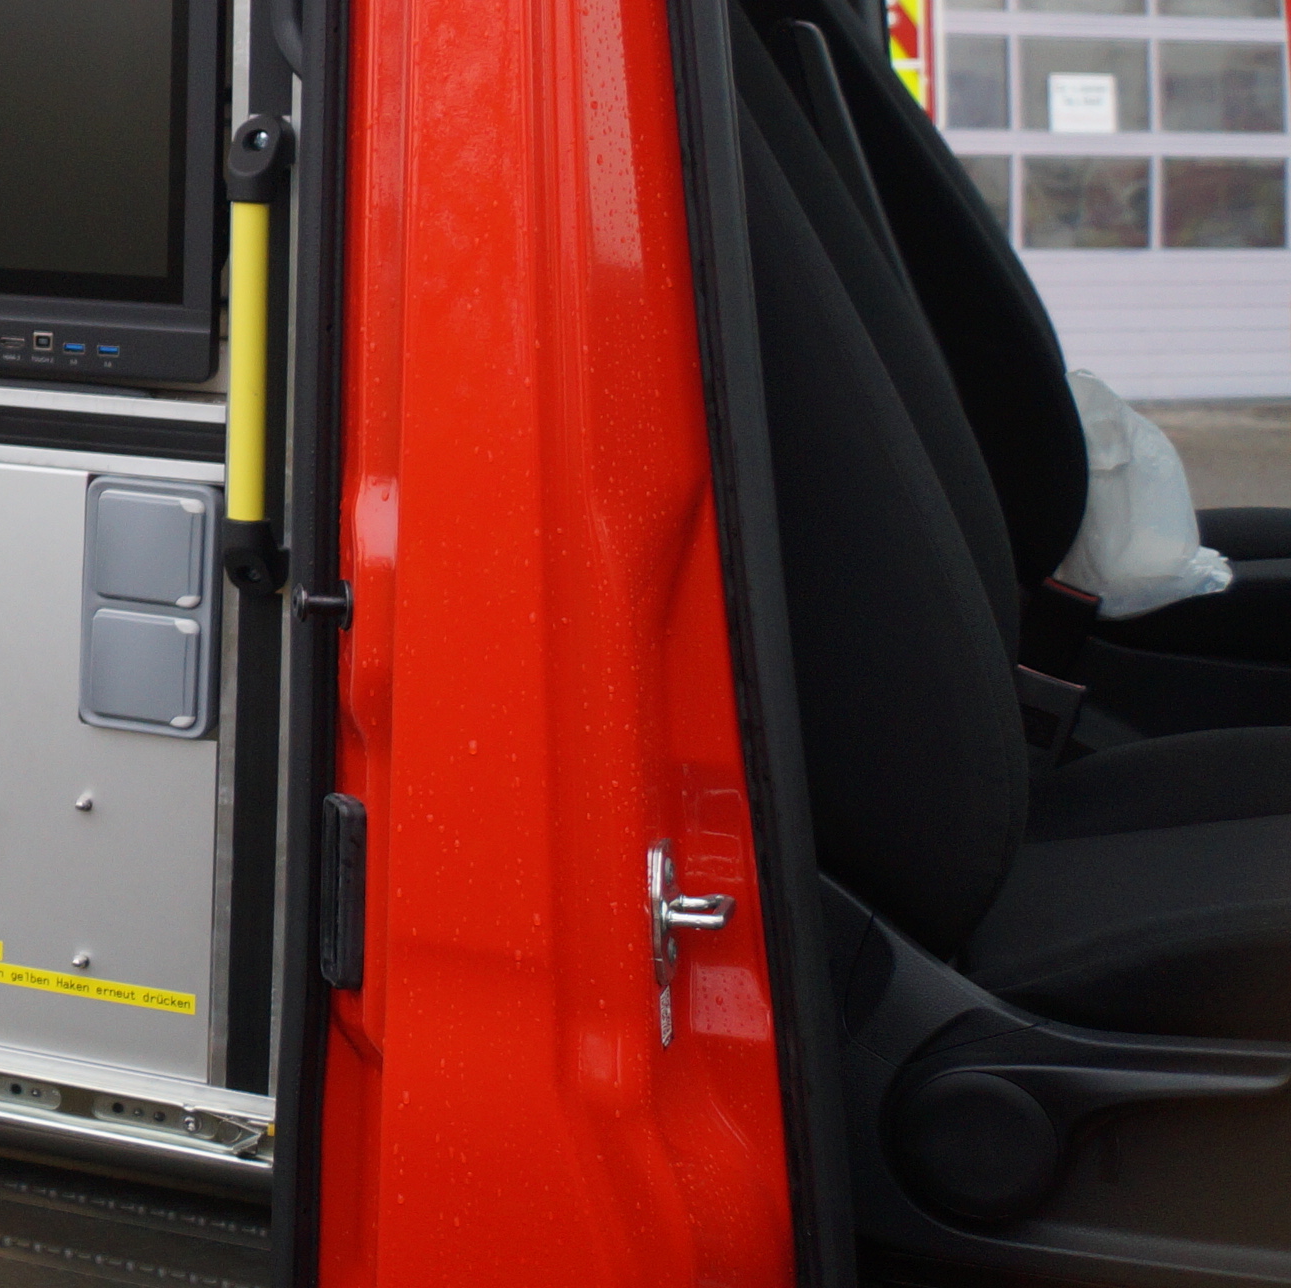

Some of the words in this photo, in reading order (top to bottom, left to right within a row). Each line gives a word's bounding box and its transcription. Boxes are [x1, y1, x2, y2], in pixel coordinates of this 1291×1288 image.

[11, 972, 50, 987] gelben
[56, 976, 90, 993] Haken
[96, 987, 136, 1001] erneut
[143, 991, 192, 1009] drücken
